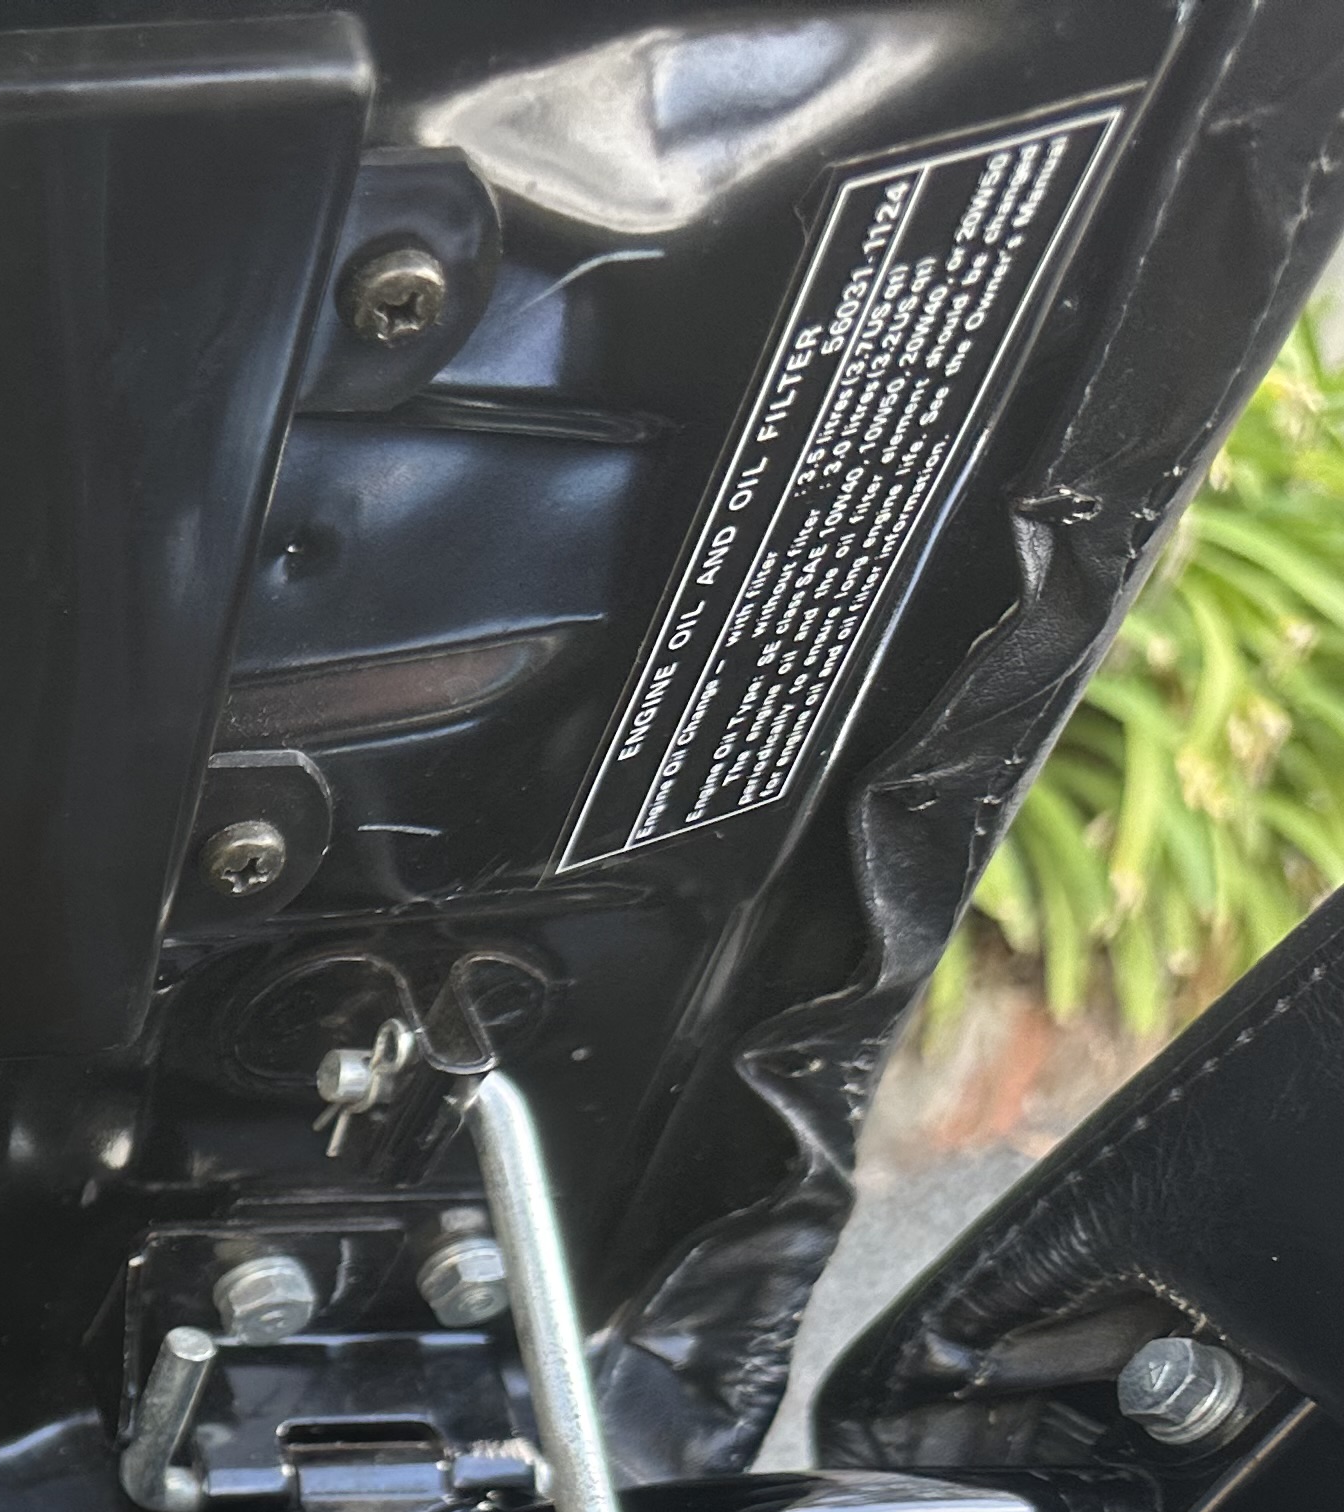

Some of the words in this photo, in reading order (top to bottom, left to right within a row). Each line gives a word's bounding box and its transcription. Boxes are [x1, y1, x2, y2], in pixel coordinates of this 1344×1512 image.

[820, 181, 910, 355] 56031-1124
[797, 447, 826, 486] 3.5
[822, 440, 852, 477] 3.0
[848, 474, 883, 524] filter
[881, 377, 930, 464] element
[617, 662, 678, 761] ENGINE
[668, 600, 706, 651] OIL
[696, 525, 737, 585] AND
[728, 456, 768, 511] OIL
[756, 325, 823, 442] FILTER
[725, 603, 755, 648] with
[744, 551, 779, 599] filter
[751, 561, 798, 639] without
[786, 508, 821, 558] filter
[756, 639, 782, 667] SE
[775, 590, 806, 635] class
[794, 543, 828, 589] SAE
[833, 555, 869, 600] long
